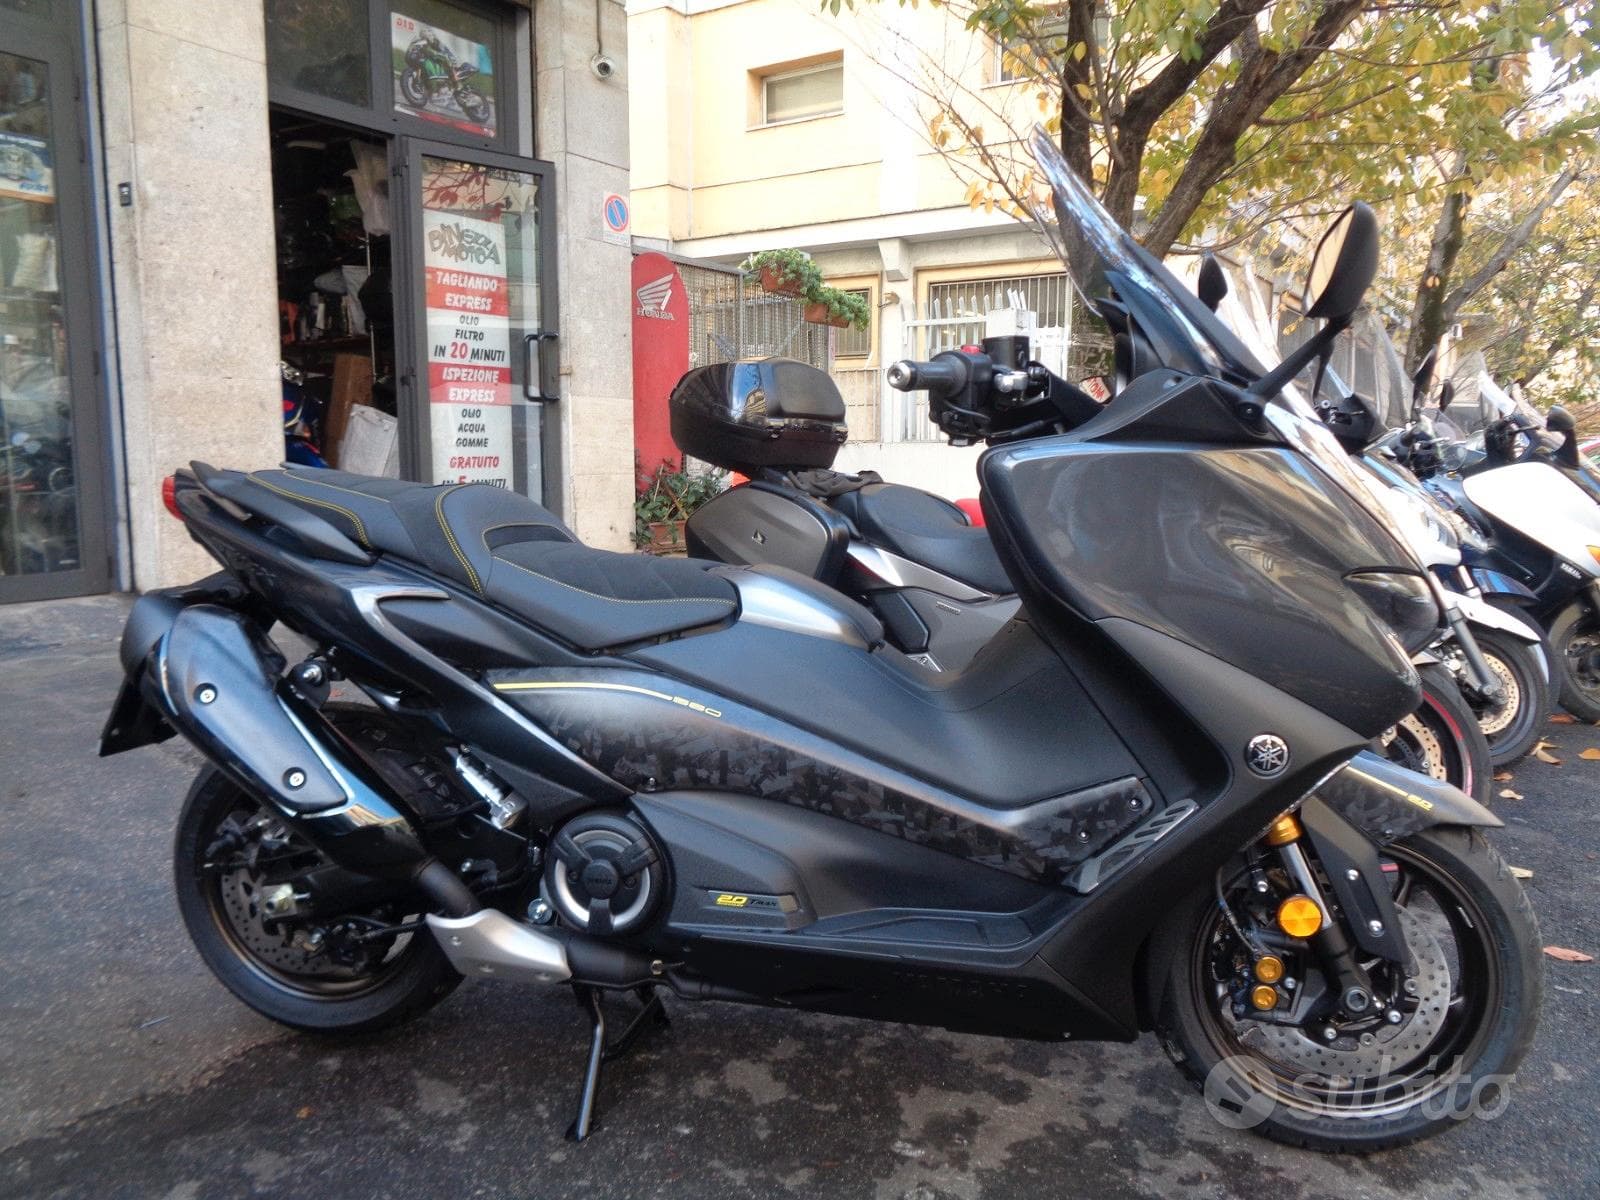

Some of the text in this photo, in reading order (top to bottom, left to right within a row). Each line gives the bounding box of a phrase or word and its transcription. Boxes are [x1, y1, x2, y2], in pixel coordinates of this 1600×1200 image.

[436, 272, 498, 291] TAGLIANDO
[445, 293, 492, 311] EXPRESS
[459, 315, 479, 326] OLIO
[455, 329, 485, 341] FILTRO
[434, 341, 505, 362] IN 20 MINUTI
[442, 366, 499, 383] ISPEZIONE
[448, 386, 496, 402] EXPRESS
[461, 408, 482, 418] OLIO
[458, 423, 486, 434] ACQUA
[456, 437, 489, 448] GOMME
[449, 455, 500, 469] GRATUITO
